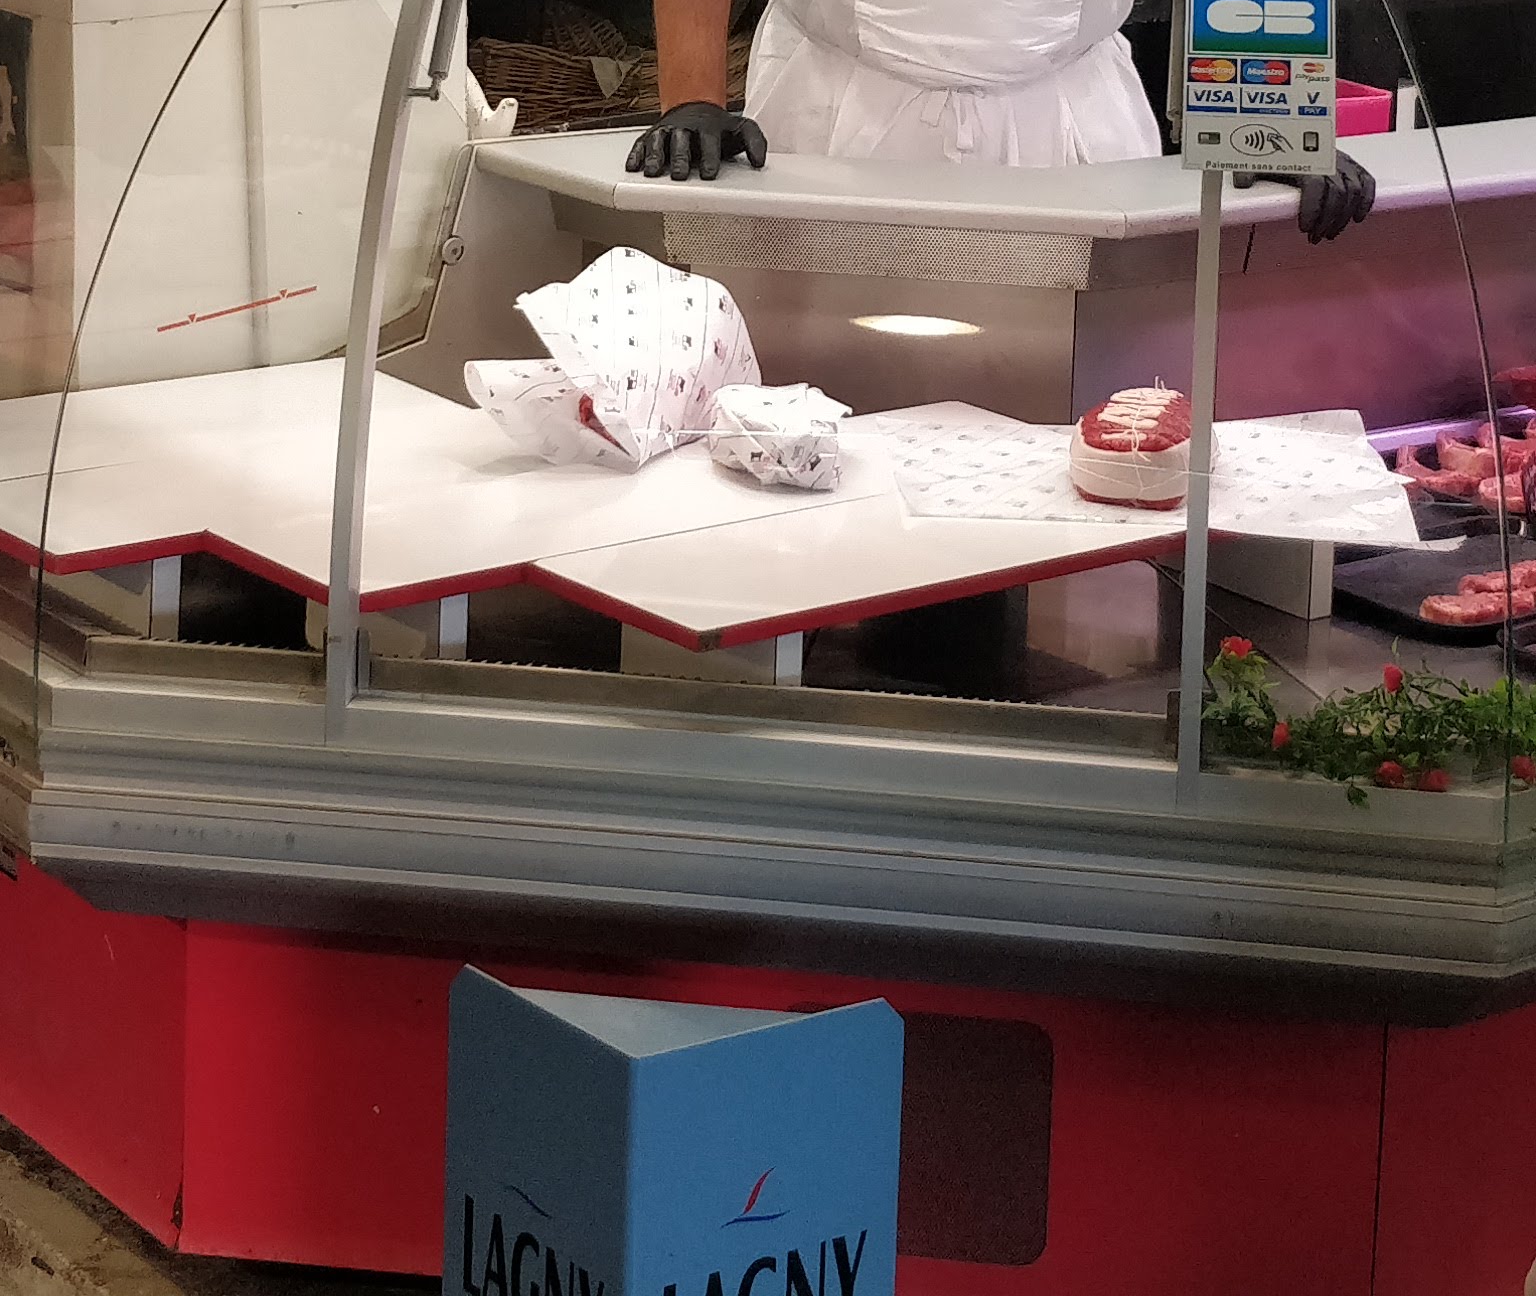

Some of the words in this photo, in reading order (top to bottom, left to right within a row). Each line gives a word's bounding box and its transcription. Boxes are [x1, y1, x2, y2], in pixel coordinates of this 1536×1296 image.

[1206, 0, 1315, 35] CB
[1194, 89, 1235, 103] VISA
[1247, 91, 1289, 105] VISA
[1205, 160, 1249, 171] Paiement
[1252, 163, 1274, 172] sans
[1276, 163, 1312, 172] contact
